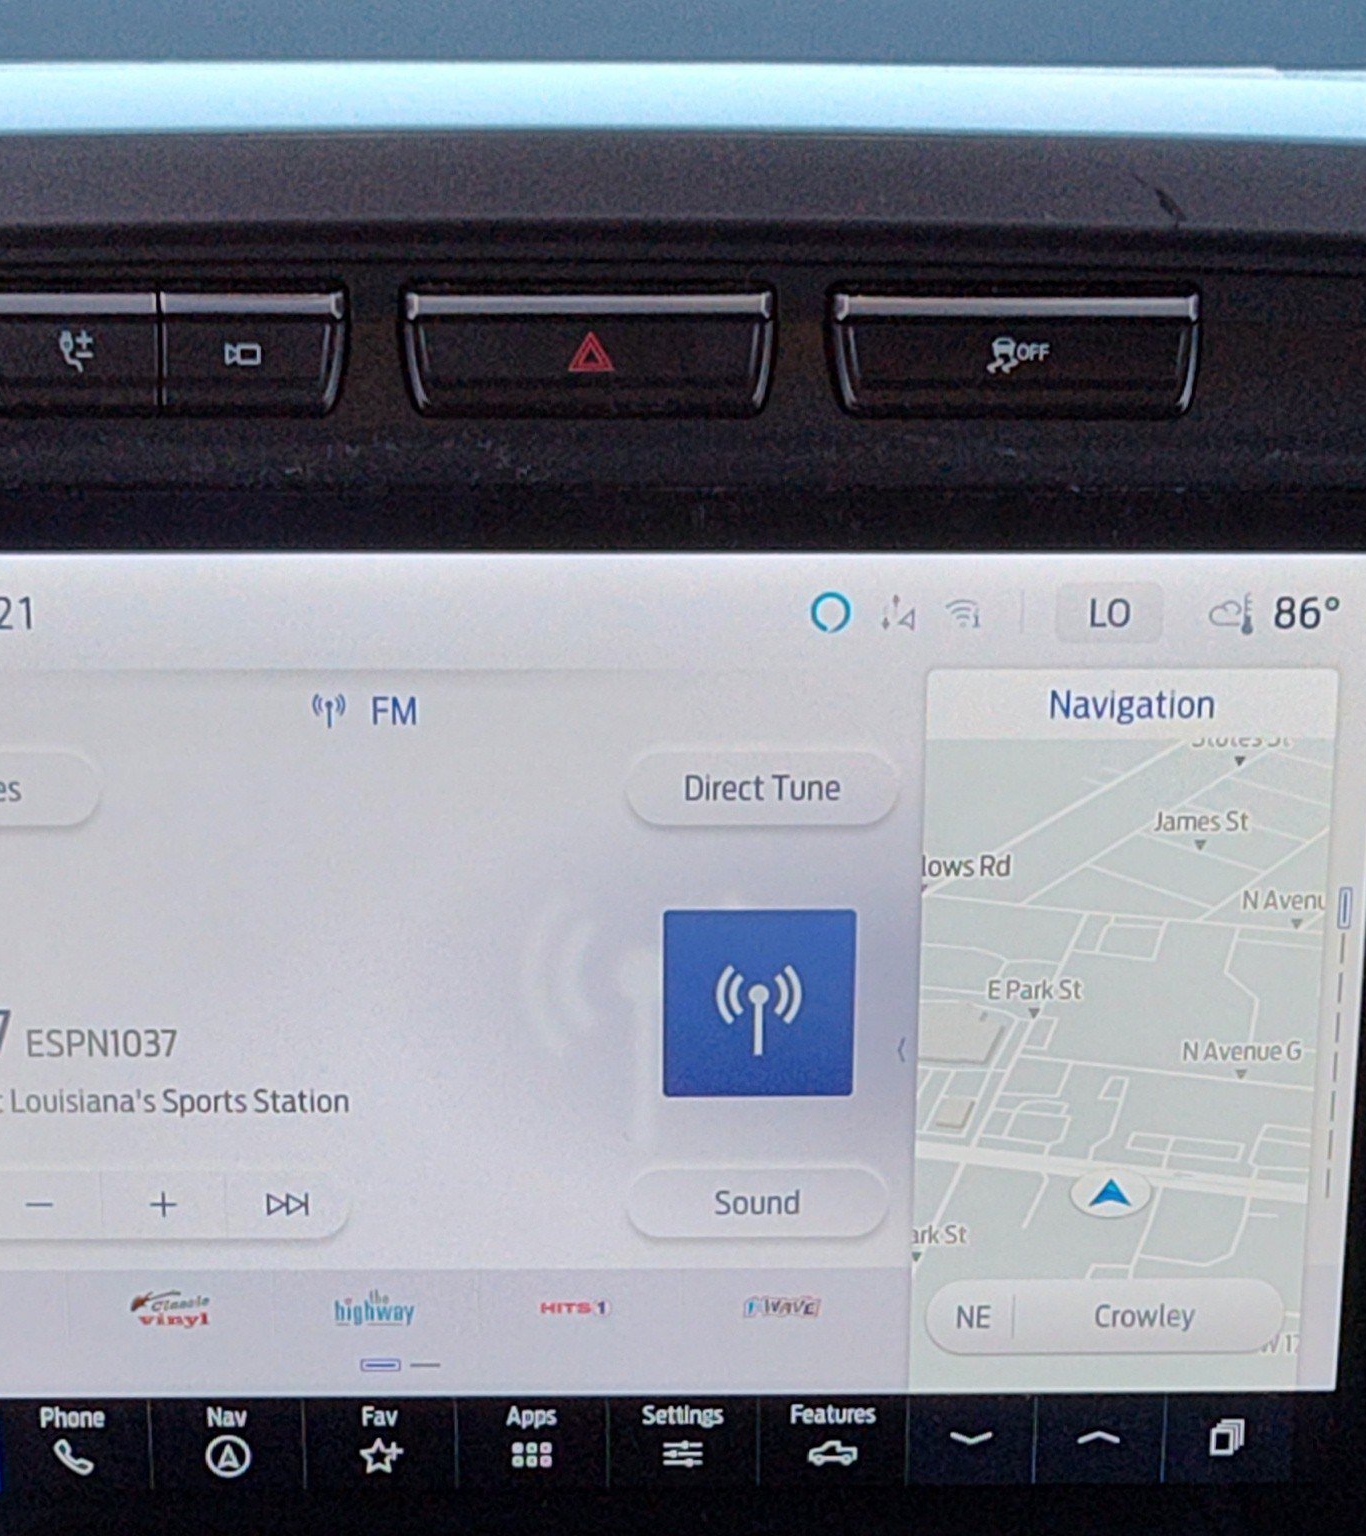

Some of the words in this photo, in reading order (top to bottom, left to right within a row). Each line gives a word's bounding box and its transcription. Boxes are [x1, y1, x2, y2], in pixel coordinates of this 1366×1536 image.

[1016, 342, 1050, 361] OFF
[1089, 598, 1131, 628] LO
[1273, 596, 1341, 630] 86°
[372, 696, 417, 726] FM
[1049, 690, 1215, 724] Navigation
[684, 774, 765, 802] Direct
[771, 774, 842, 802] Tune
[1154, 811, 1221, 832] James
[1226, 811, 1249, 832] St
[980, 855, 1011, 877] Rd
[1242, 889, 1259, 910] N
[988, 980, 1001, 1000] E
[1006, 979, 1054, 1000] Park
[1059, 979, 1083, 1000] St
[27, 1029, 178, 1058] ESPN1037
[1182, 1041, 1199, 1061] N
[1203, 1041, 1283, 1061] Avenue
[1286, 1041, 1303, 1061] G
[11, 1088, 156, 1114] Louisiana's
[162, 1088, 248, 1118] Sports
[253, 1088, 350, 1114] Station
[715, 1190, 801, 1216] Sound
[944, 1224, 967, 1245] St
[369, 1289, 390, 1304] the
[334, 1298, 415, 1327] highway
[956, 1305, 992, 1329] NE
[1094, 1303, 1196, 1332] Crowley
[40, 1406, 105, 1430] Phone
[206, 1407, 247, 1428] Nav
[361, 1407, 398, 1428] Fav
[506, 1405, 558, 1430] Apps
[641, 1404, 724, 1429] Settings
[789, 1404, 877, 1425] Features
